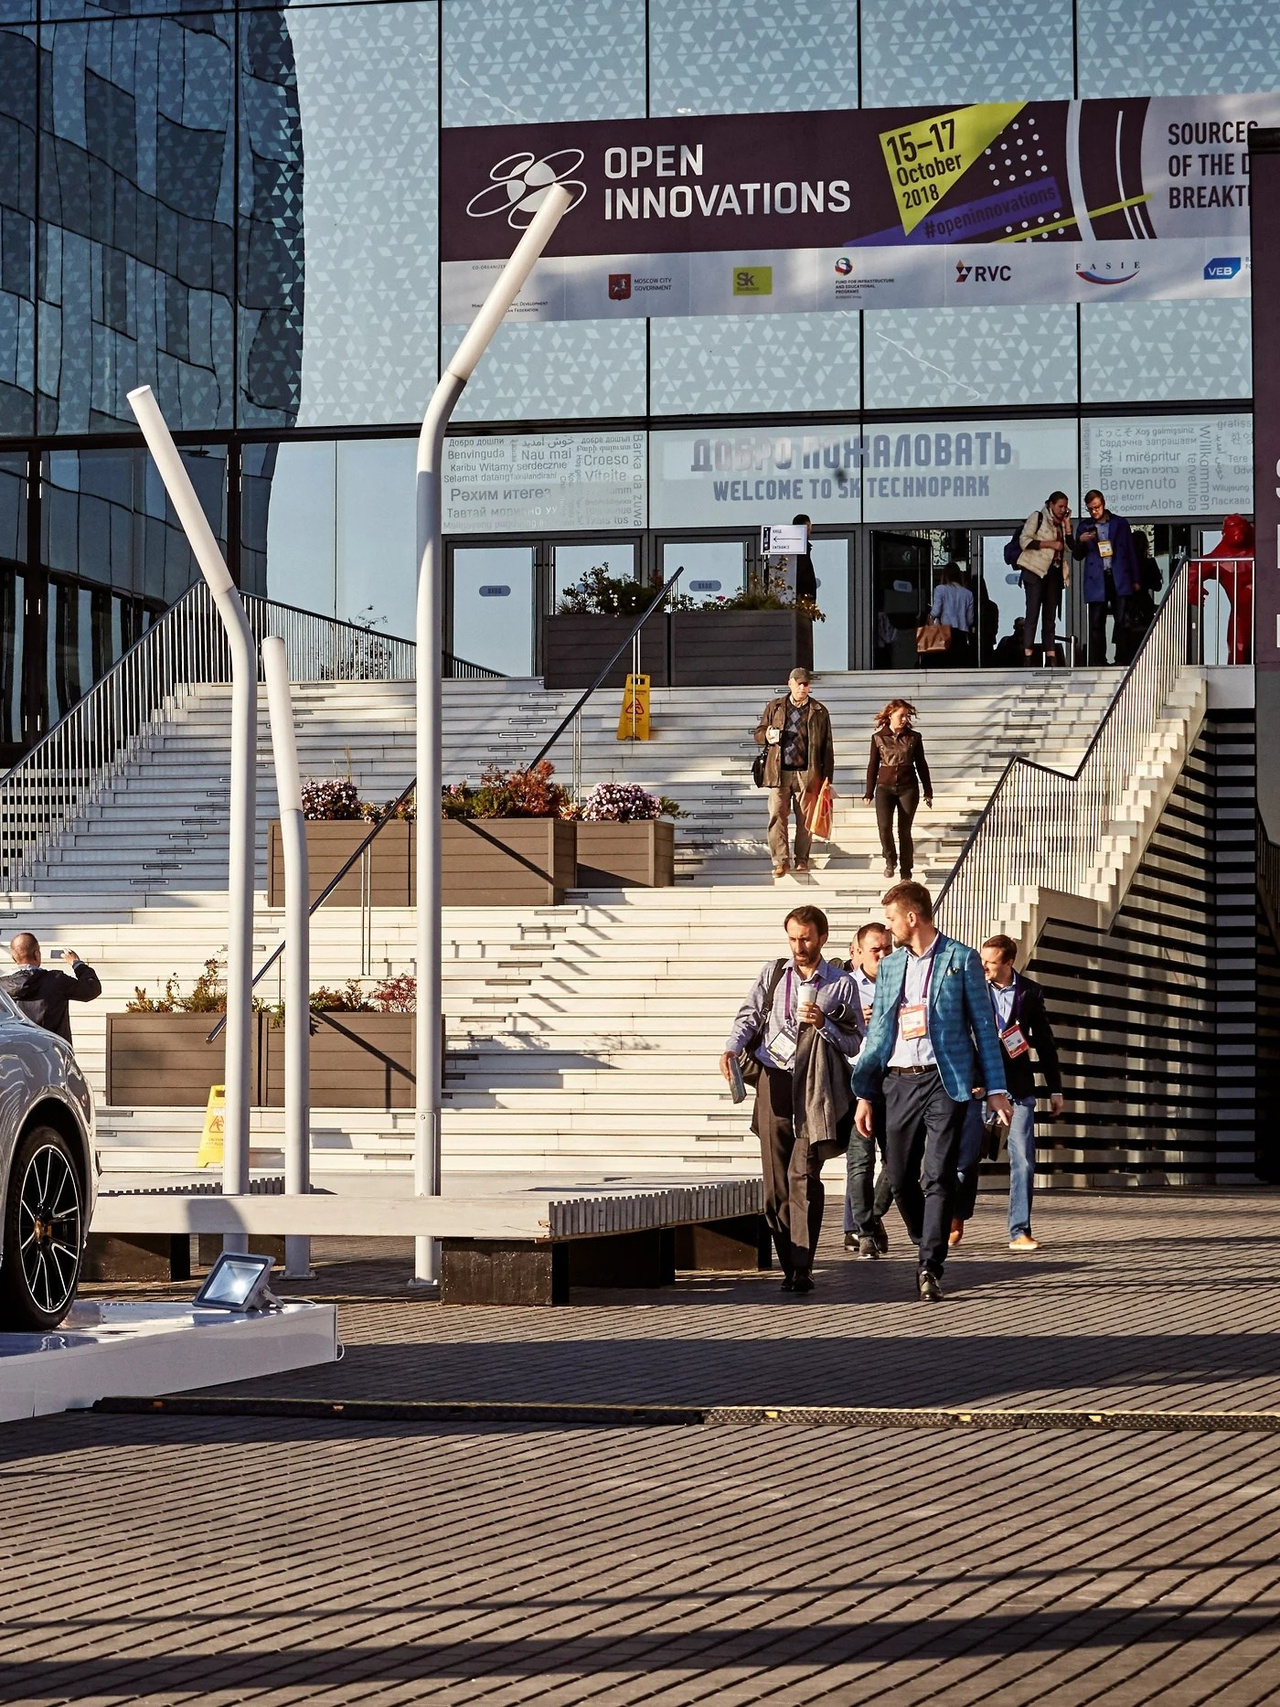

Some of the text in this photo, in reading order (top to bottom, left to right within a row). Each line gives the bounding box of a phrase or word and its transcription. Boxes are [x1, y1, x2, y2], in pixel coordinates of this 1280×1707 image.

[604, 143, 704, 179] OPEN
[1168, 155, 1191, 178] OF
[1197, 152, 1239, 177] THE
[896, 152, 963, 187] October
[604, 180, 851, 220] INNOVATIONS
[902, 183, 940, 210] 2018
[923, 184, 1058, 239] #openinnovations
[975, 265, 1012, 282] RVC
[1208, 266, 1233, 276] VEB
[736, 272, 755, 287] Sk
[634, 284, 672, 292] GOVERNMENT
[448, 437, 505, 447] Добро дошли
[448, 448, 505, 460] Benvinguda
[521, 450, 545, 460] Nau
[549, 448, 572, 459] mai
[691, 431, 1012, 472] ДОБРО ПОЖАЛОВАТЬ
[1125, 450, 1181, 464] mirëpritur
[1228, 454, 1248, 463] Tere
[450, 461, 568, 473] Karibu Witamy serdecznie
[583, 454, 629, 466] Croeso
[1200, 424, 1212, 511] Willkommen
[443, 475, 478, 483] Selamat
[480, 473, 510, 482] datang
[632, 434, 643, 527] Barka da zuwa
[1100, 476, 1177, 491] Benvenuto
[1188, 452, 1198, 512] tervetuloa
[450, 488, 499, 502] Рәхим
[713, 475, 990, 502] WELCOME TO SK TECHNOPARK
[1150, 498, 1183, 510] Aloha
[446, 507, 487, 518] Тавтай
